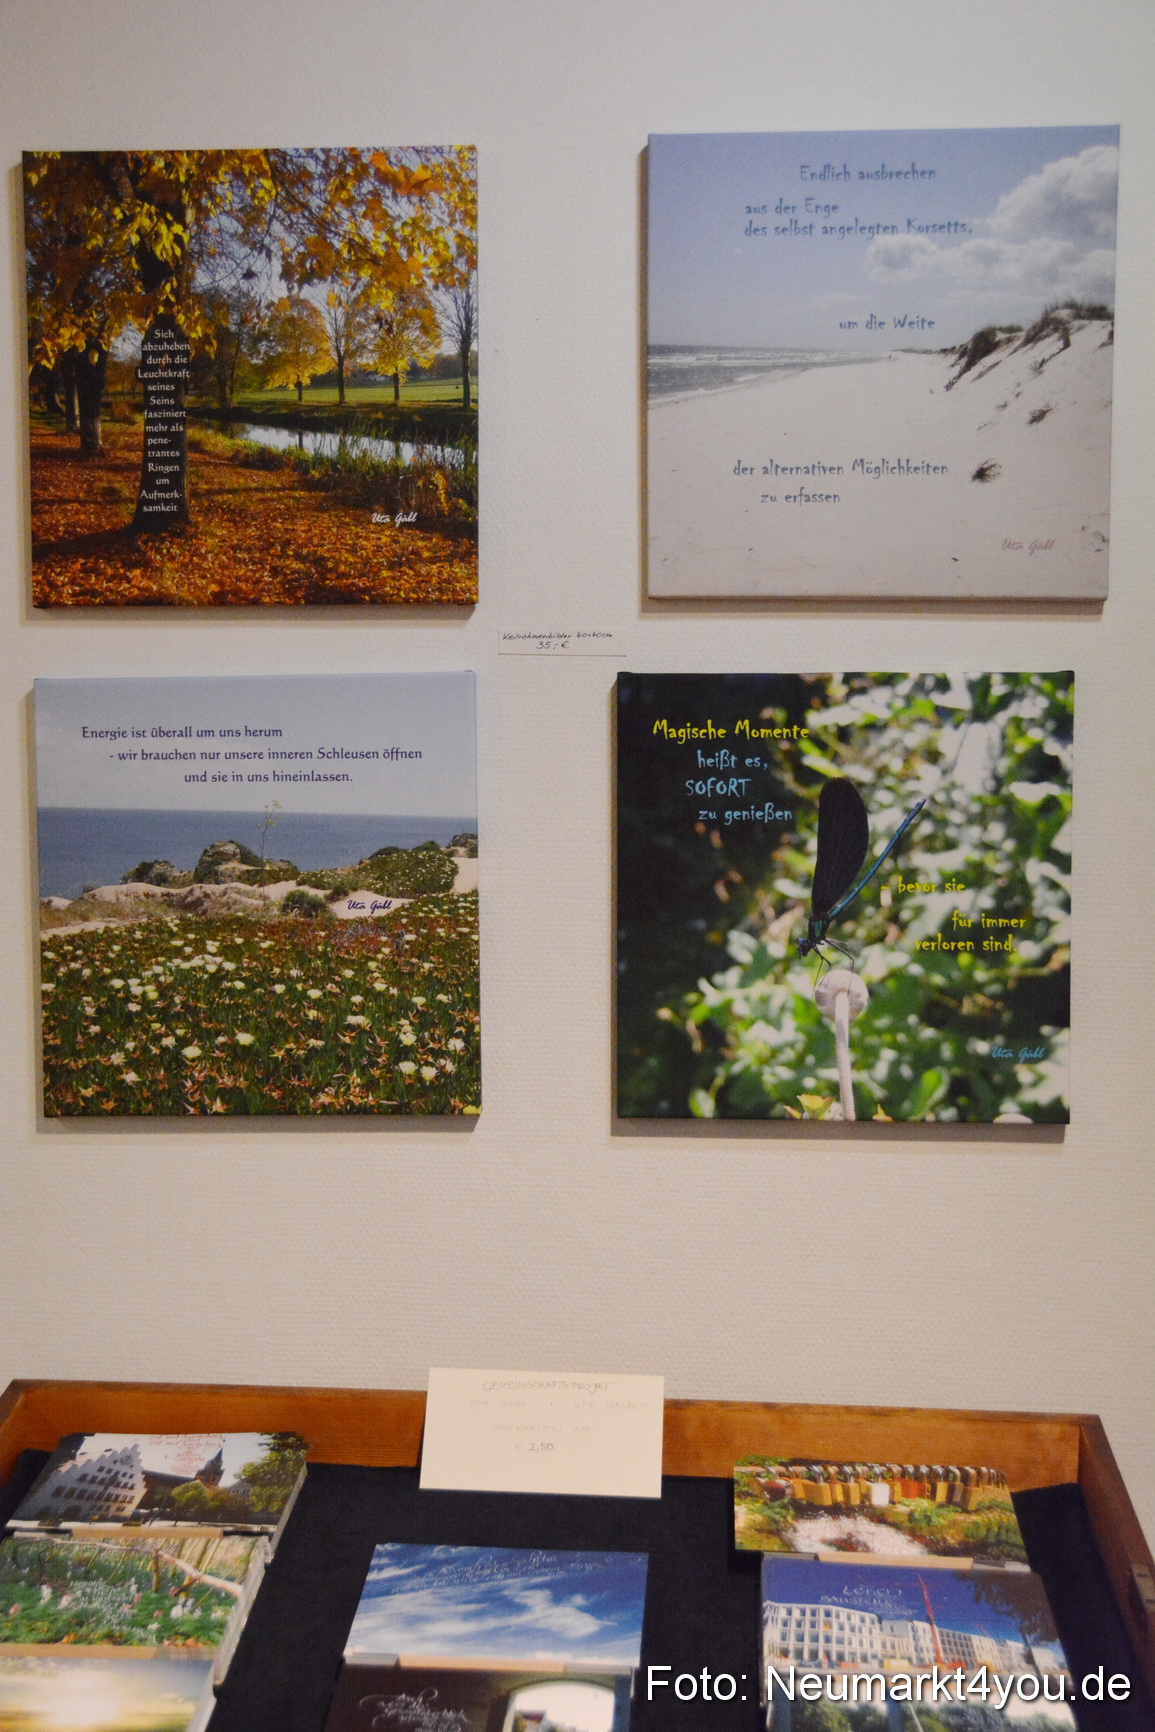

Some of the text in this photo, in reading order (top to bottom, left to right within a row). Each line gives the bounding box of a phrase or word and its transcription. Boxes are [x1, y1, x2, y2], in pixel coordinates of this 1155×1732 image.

[800, 162, 937, 181] Endlich ausbrechen
[744, 197, 840, 219] aus der Enge
[744, 217, 973, 240] des selbst angelegten Korsetts,
[839, 314, 936, 330] um die Weite
[154, 329, 174, 338] Sich
[142, 343, 191, 351] abzuheben
[146, 355, 188, 365] durch die
[137, 369, 191, 379] Leuchtkraft
[147, 383, 175, 391] seines
[150, 396, 175, 405] Seins
[144, 409, 187, 419] fasziniert
[146, 423, 184, 432] mehr als
[147, 437, 172, 446] pene-
[147, 449, 180, 457] trantes
[147, 463, 180, 474] Ringen
[733, 458, 949, 480] der alternativen Möglichkeiten
[139, 490, 183, 501] Aufmerk-
[760, 487, 841, 506] zu erfassen
[143, 503, 178, 512] samkeit
[371, 512, 391, 523] Uta
[502, 632, 572, 641] Keilrahmenbilder
[561, 640, 570, 649] €
[81, 726, 283, 741] Energie ist überall um uns herum
[653, 719, 810, 745] Magische Momente
[118, 749, 138, 761] wir
[141, 748, 196, 761] brauchen
[200, 750, 221, 760] nur
[224, 749, 264, 760] unsere
[267, 748, 313, 760] inneren
[317, 747, 379, 760] Schleusen
[382, 747, 423, 762] öffnen
[697, 749, 768, 771] heißt es,
[184, 770, 353, 783] und sie in uns hineinlassen.
[685, 777, 752, 798] SOFORT
[698, 802, 793, 826] zu genießen
[898, 875, 938, 894] bevor
[945, 878, 966, 893] sie
[347, 900, 366, 910] Uta
[951, 910, 1026, 931] für immer
[914, 932, 1019, 953] verloren sind.
[991, 1045, 1014, 1059] Uta
[528, 1442, 554, 1453] 2,50
